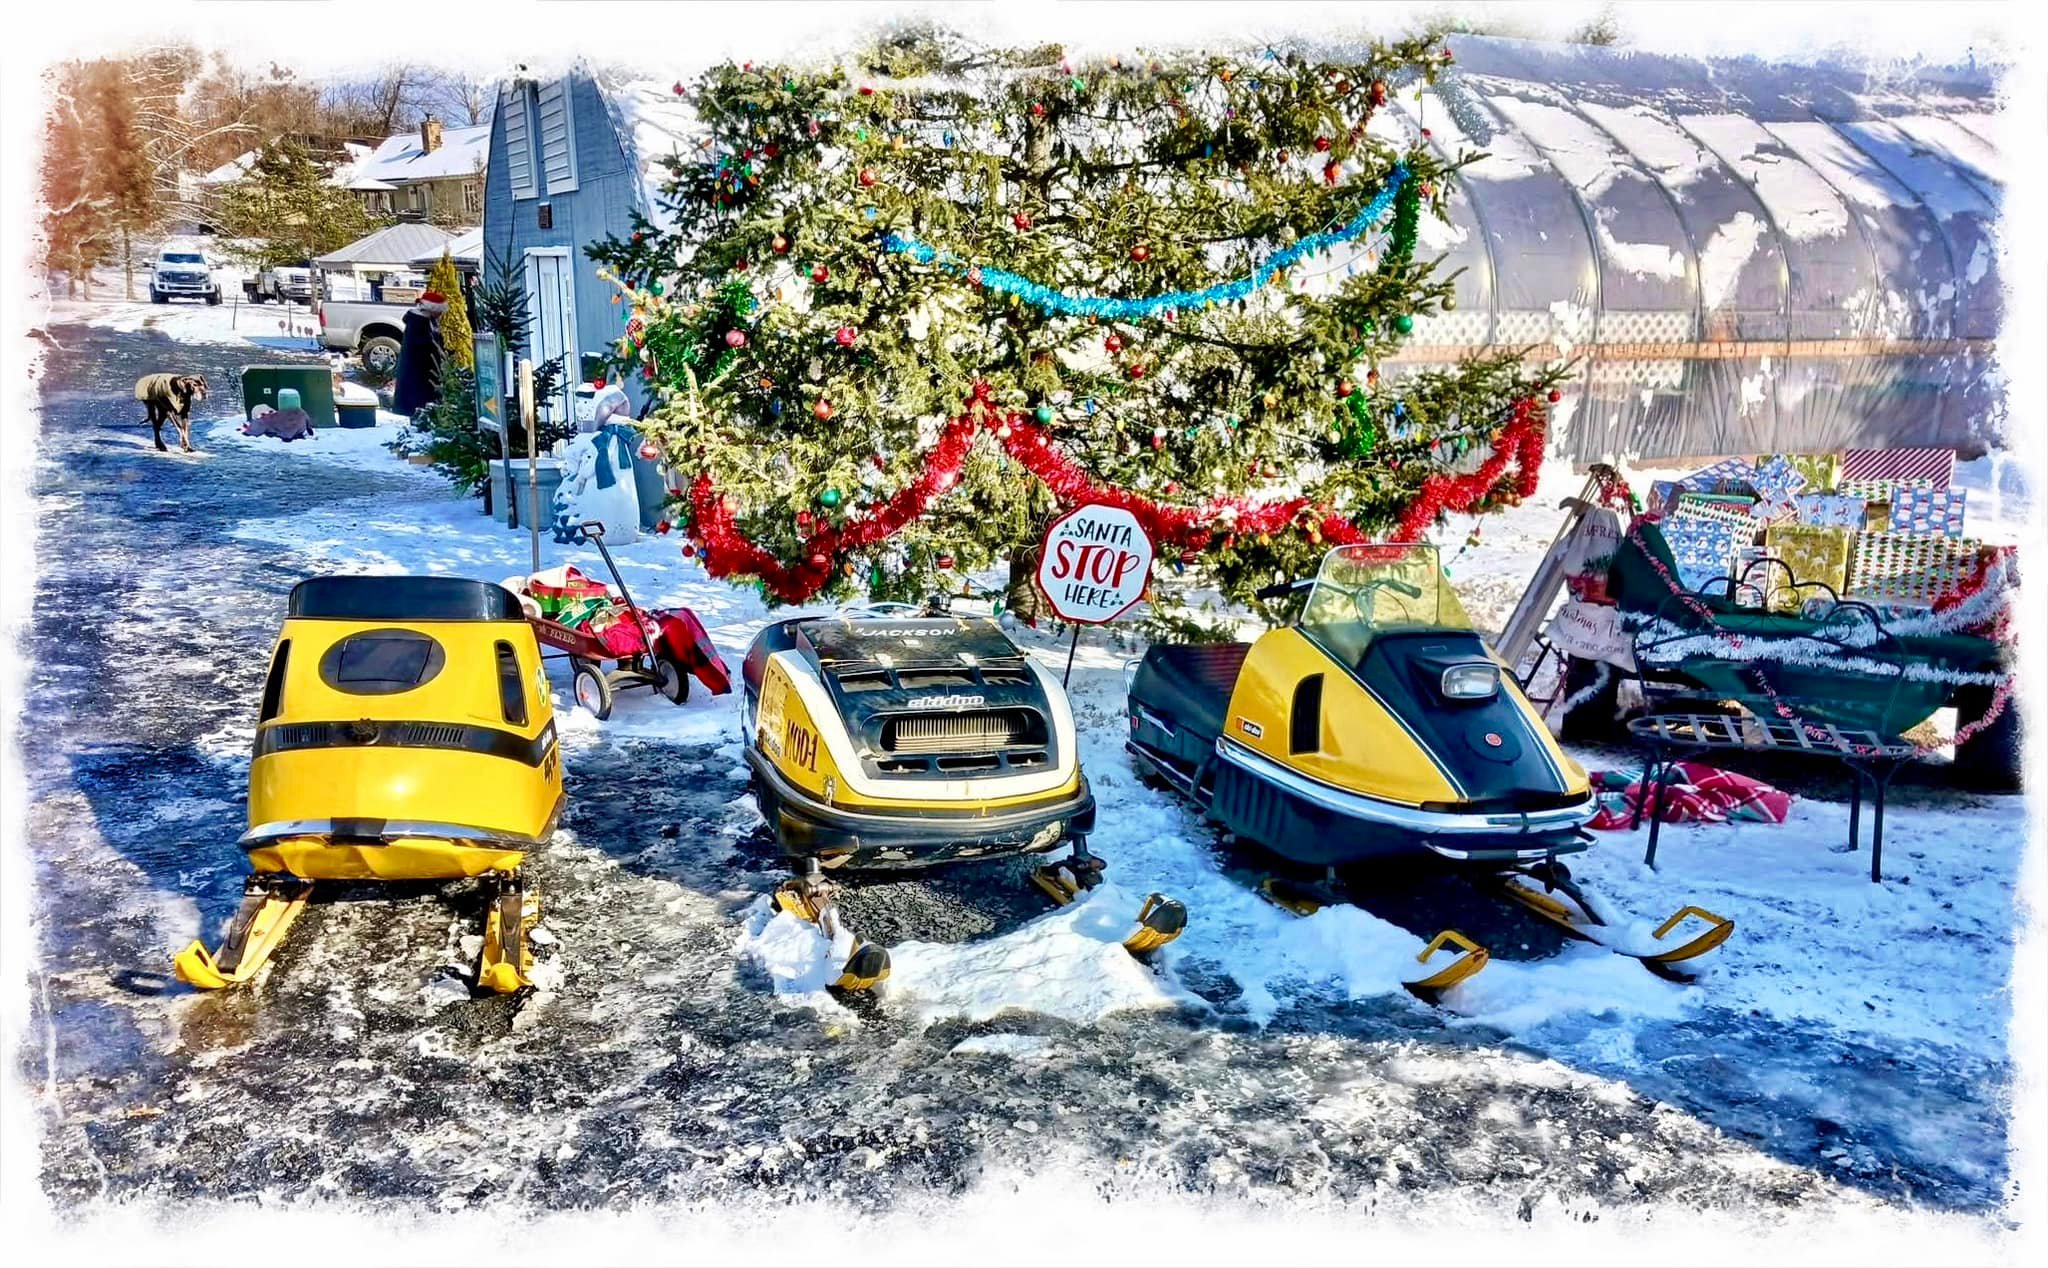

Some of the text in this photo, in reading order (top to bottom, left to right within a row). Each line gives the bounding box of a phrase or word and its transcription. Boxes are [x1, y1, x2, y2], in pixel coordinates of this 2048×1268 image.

[1075, 518, 1132, 547] SANTA
[1051, 540, 1140, 588] STOP
[1064, 583, 1112, 608] HERE
[785, 719, 818, 773] MOD-1
